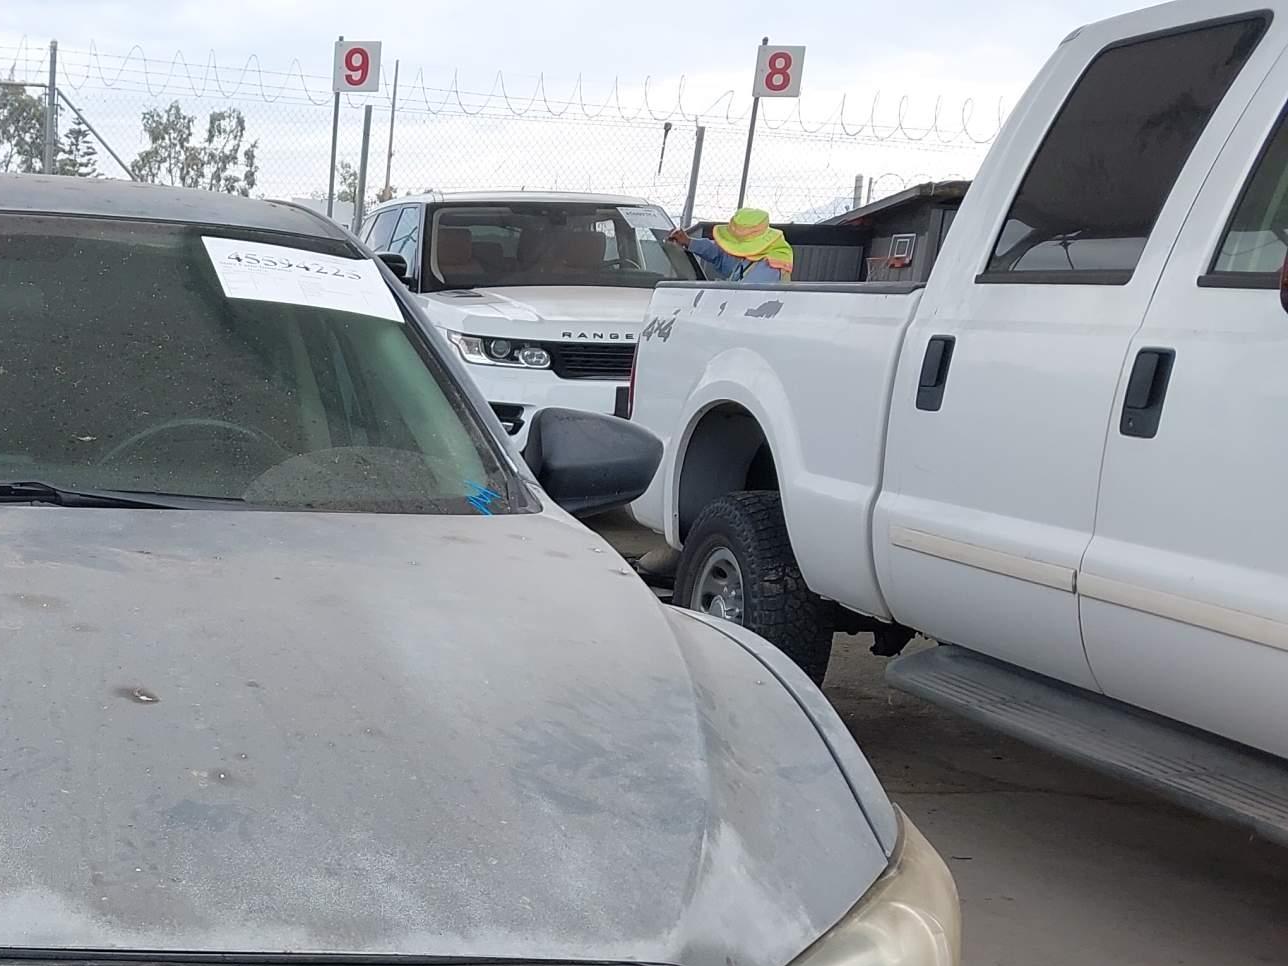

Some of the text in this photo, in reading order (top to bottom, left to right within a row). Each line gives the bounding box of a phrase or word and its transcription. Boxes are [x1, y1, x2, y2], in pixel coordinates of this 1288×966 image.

[344, 47, 369, 86] 9
[765, 52, 792, 91] 8
[227, 251, 362, 281] 45594225
[562, 331, 634, 340] RANGE
